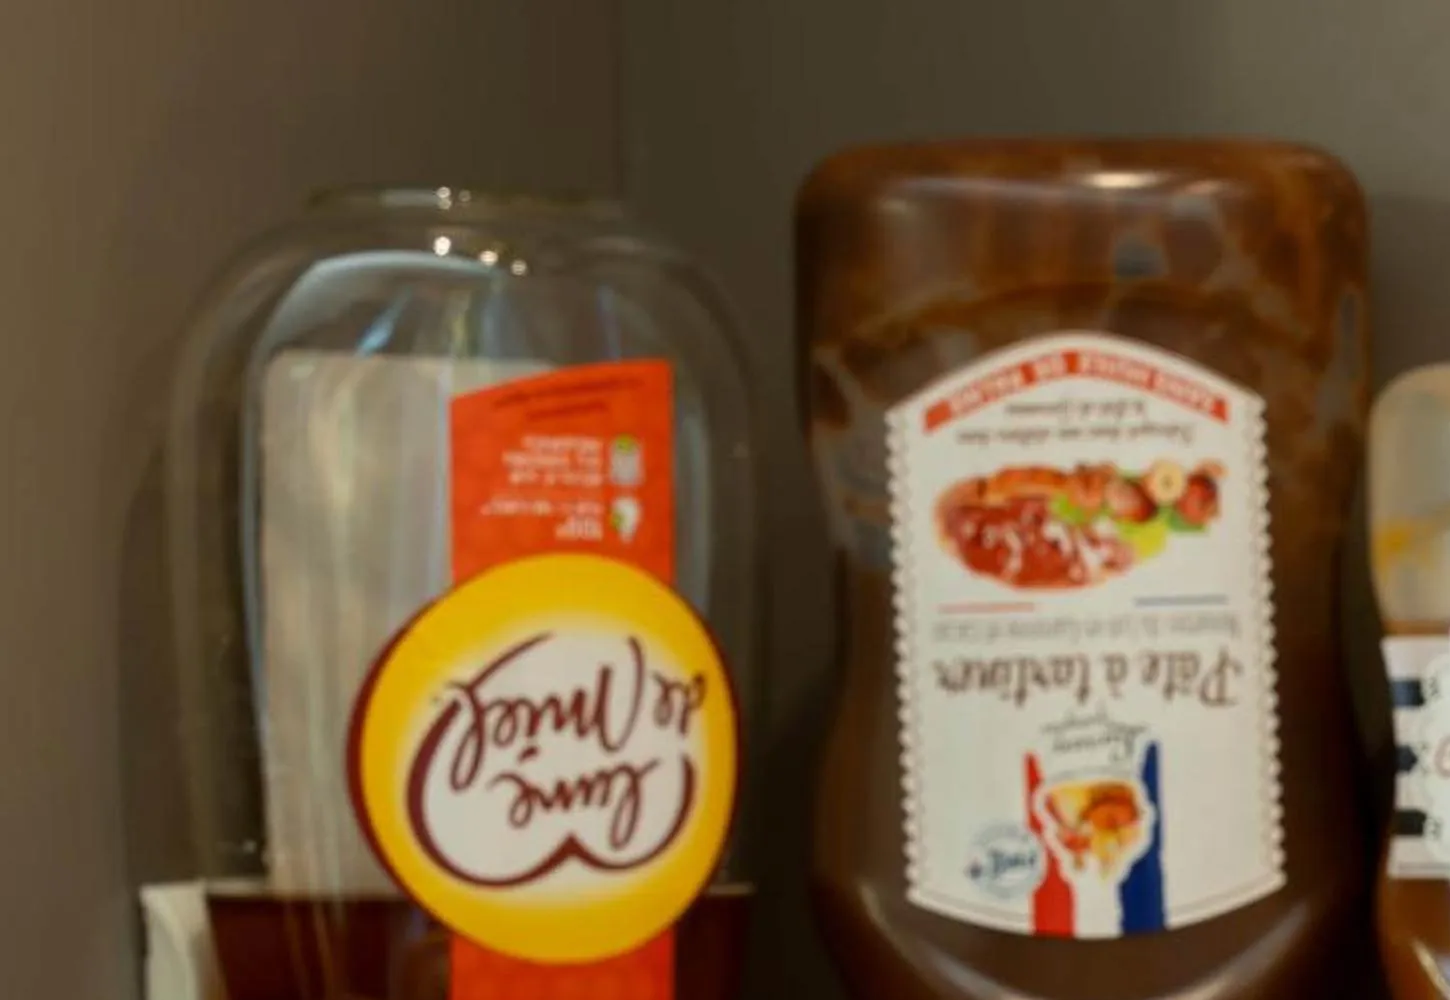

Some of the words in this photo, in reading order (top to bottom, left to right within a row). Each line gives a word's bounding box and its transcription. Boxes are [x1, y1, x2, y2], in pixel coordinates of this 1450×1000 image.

[931, 653, 1090, 709] tartiner
[1103, 653, 1130, 702] à
[1140, 645, 1244, 708] Pâte
